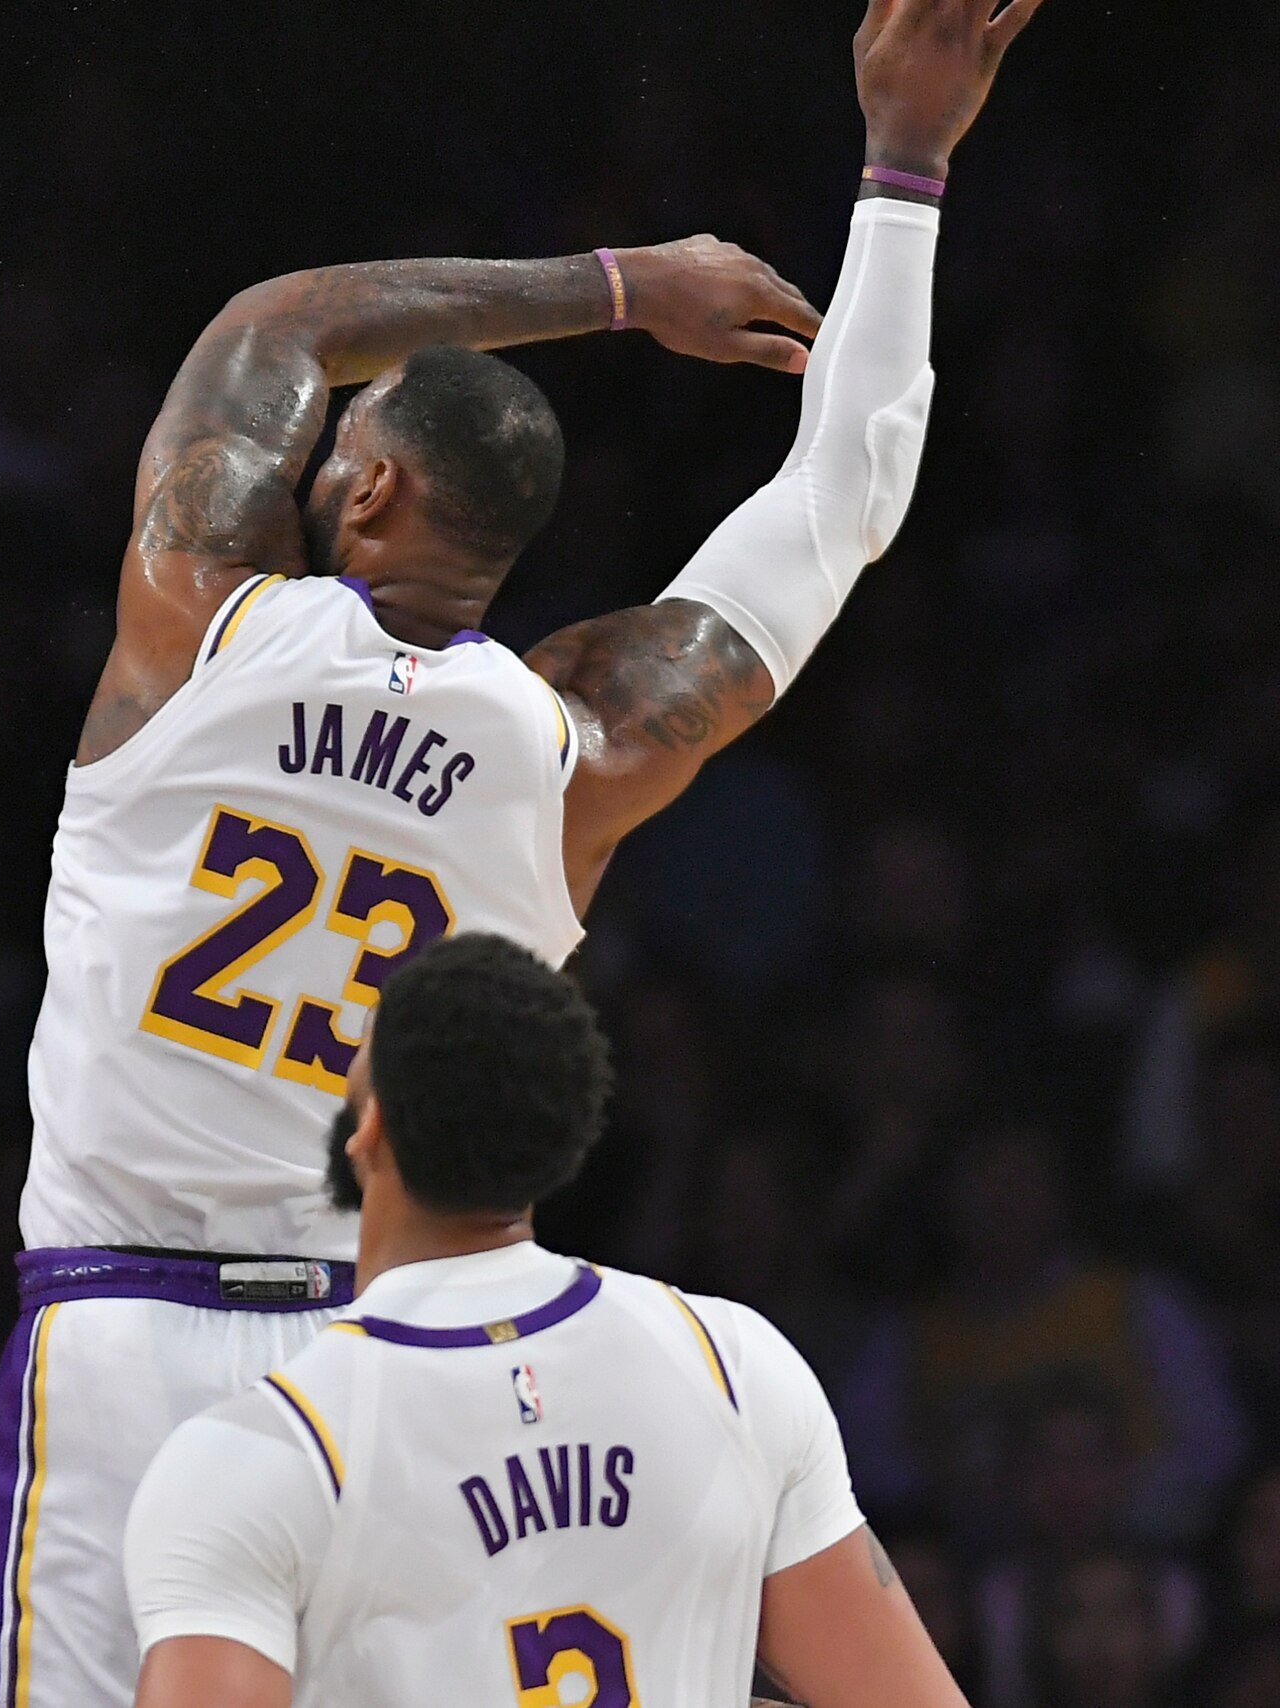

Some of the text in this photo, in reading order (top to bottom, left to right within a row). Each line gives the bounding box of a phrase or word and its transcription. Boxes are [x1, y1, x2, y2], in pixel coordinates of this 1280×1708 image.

[278, 702, 476, 817] JAMES
[138, 802, 457, 1098] 23
[459, 1443, 634, 1557] DAVIS
